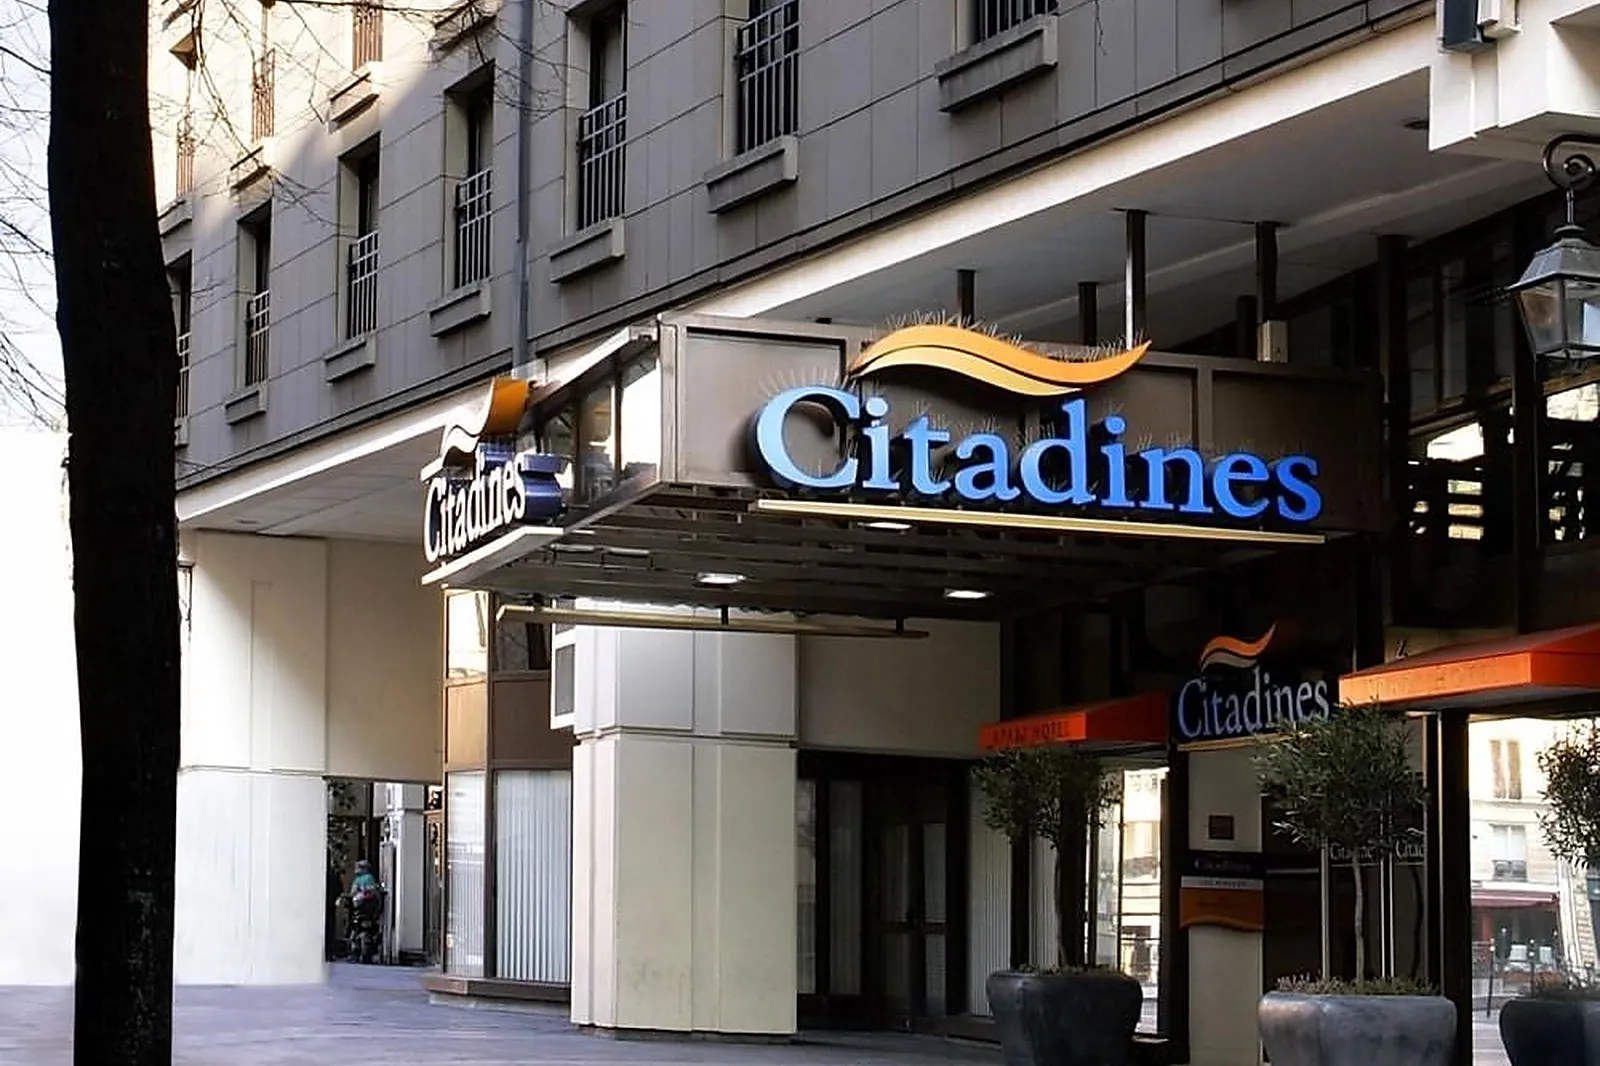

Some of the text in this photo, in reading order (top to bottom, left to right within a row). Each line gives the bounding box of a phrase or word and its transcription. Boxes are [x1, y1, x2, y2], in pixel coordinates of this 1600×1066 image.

[424, 444, 526, 562] Citadines
[756, 385, 1323, 522] Citadines
[1178, 665, 1330, 738] Citadines
